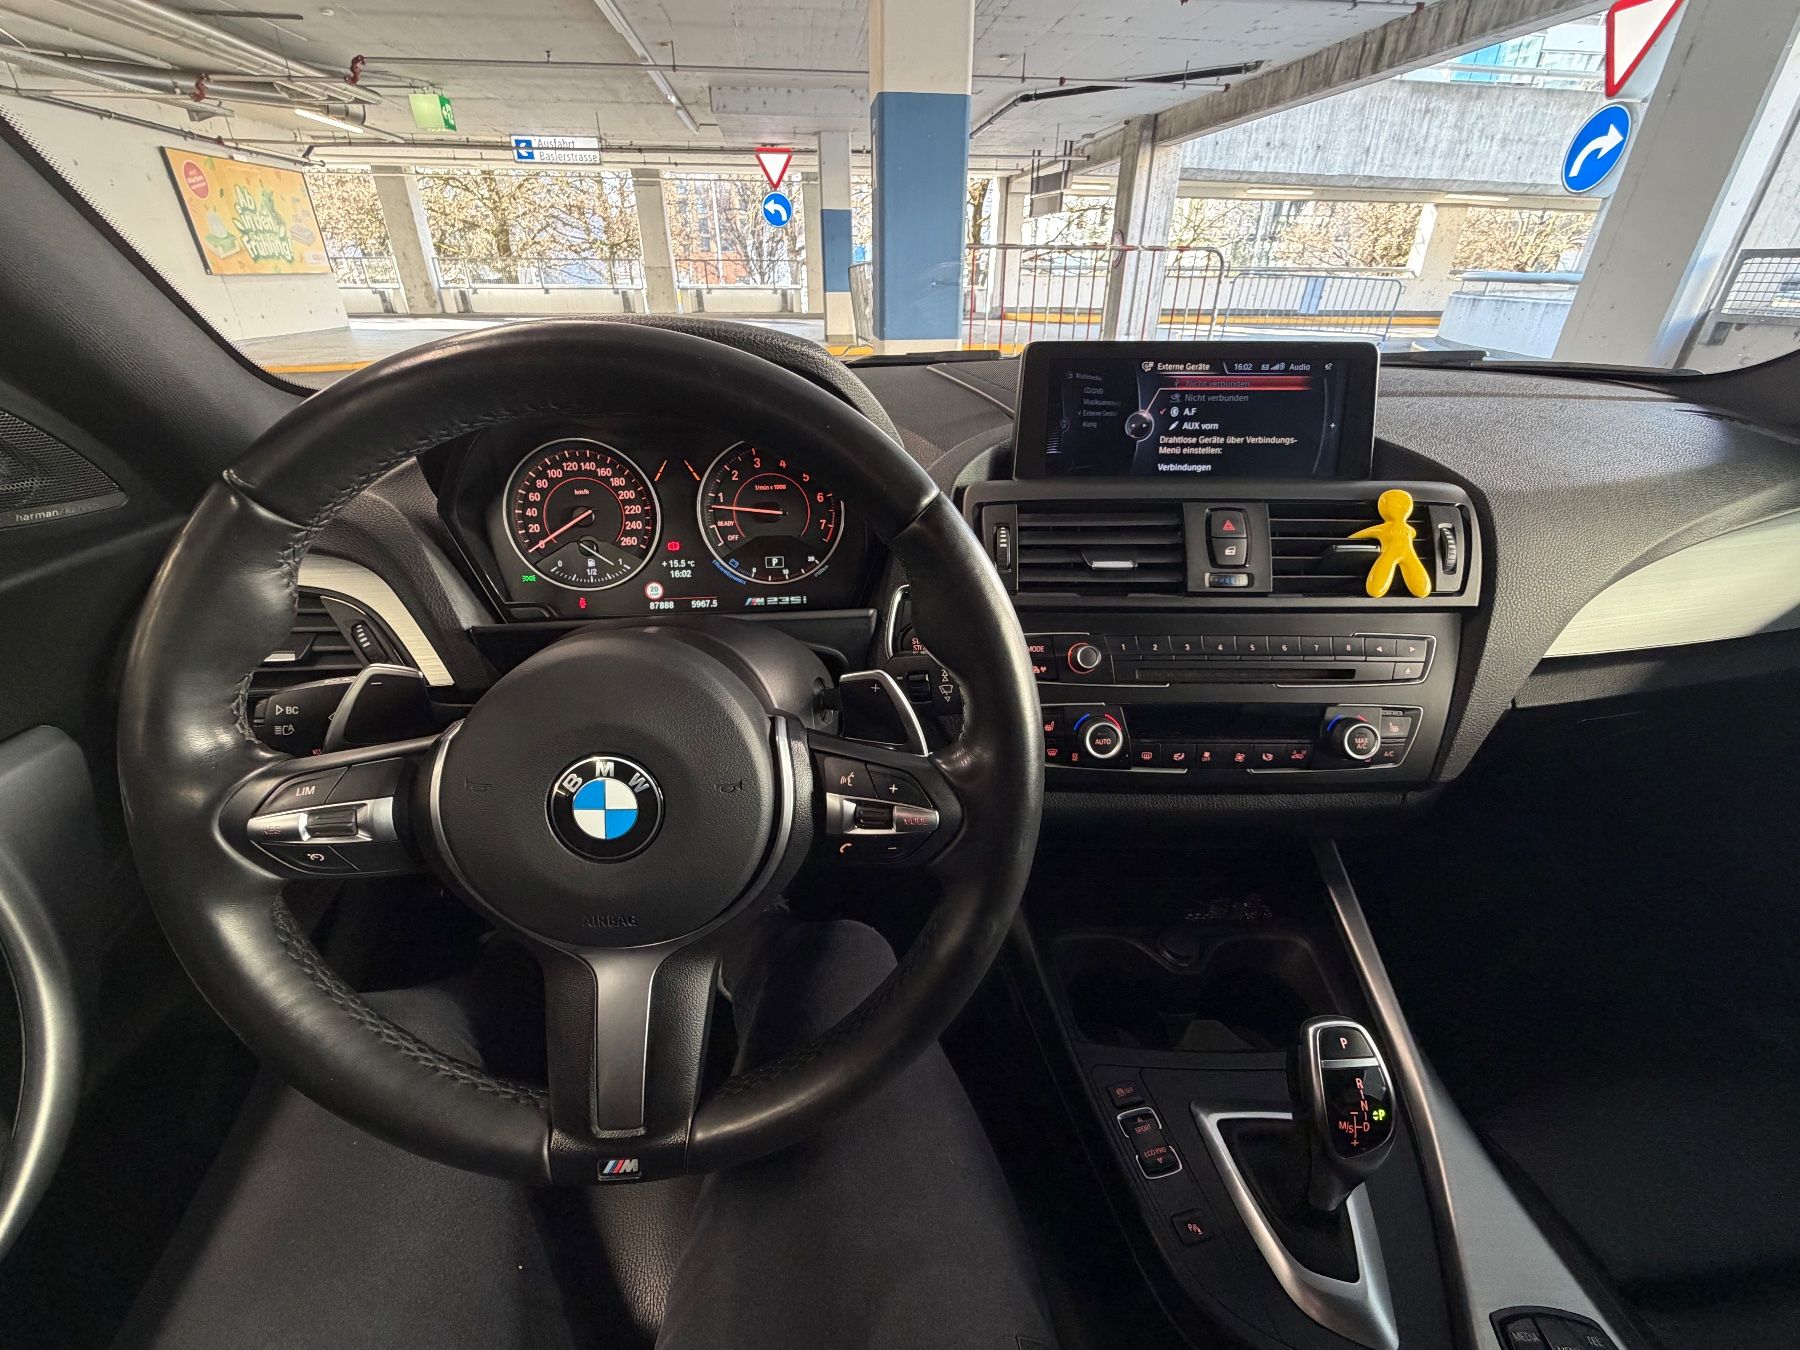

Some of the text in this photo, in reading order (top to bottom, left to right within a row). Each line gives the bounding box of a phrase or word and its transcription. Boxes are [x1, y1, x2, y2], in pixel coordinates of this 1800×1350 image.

[537, 138, 576, 148] Ausfahrt
[540, 152, 598, 162] Baslerstrasse
[242, 235, 294, 261] Frühling!
[1157, 362, 1210, 371] Externe Geräte
[1182, 422, 1200, 430] AUX
[1159, 436, 1298, 445] Drahtlose Geräte über Verbindungs-
[562, 462, 578, 470] 120
[580, 462, 596, 470] 140
[754, 458, 760, 468] 3
[780, 460, 786, 468] 4
[597, 468, 612, 476] 160
[1158, 464, 1211, 472] Verbindungen
[547, 470, 562, 478] 100
[732, 470, 738, 481] 2
[803, 473, 810, 482] 5
[536, 480, 548, 488] 80
[610, 478, 625, 486] 180
[529, 492, 540, 501] 60
[619, 490, 635, 499] 200
[718, 492, 723, 502] 1
[817, 492, 824, 502] 6
[526, 508, 537, 516] 40
[625, 506, 641, 514] 220
[528, 524, 540, 532] 20
[625, 521, 642, 530] 240
[820, 520, 826, 530] 7
[621, 537, 637, 546] 260
[691, 599, 718, 608] 5967.5
[285, 706, 299, 715] BC
[562, 761, 650, 793] BMW
[296, 786, 316, 796] LIM
[582, 914, 637, 928] AIRBAG
[1340, 1038, 1348, 1049] P
[1355, 1078, 1364, 1089] R
[1361, 1100, 1368, 1111] N
[1135, 1124, 1151, 1134] SPORT
[1339, 1121, 1354, 1133] M/S
[1363, 1122, 1370, 1132] D
[1144, 1149, 1155, 1158] ECO
[618, 1159, 639, 1173] M
